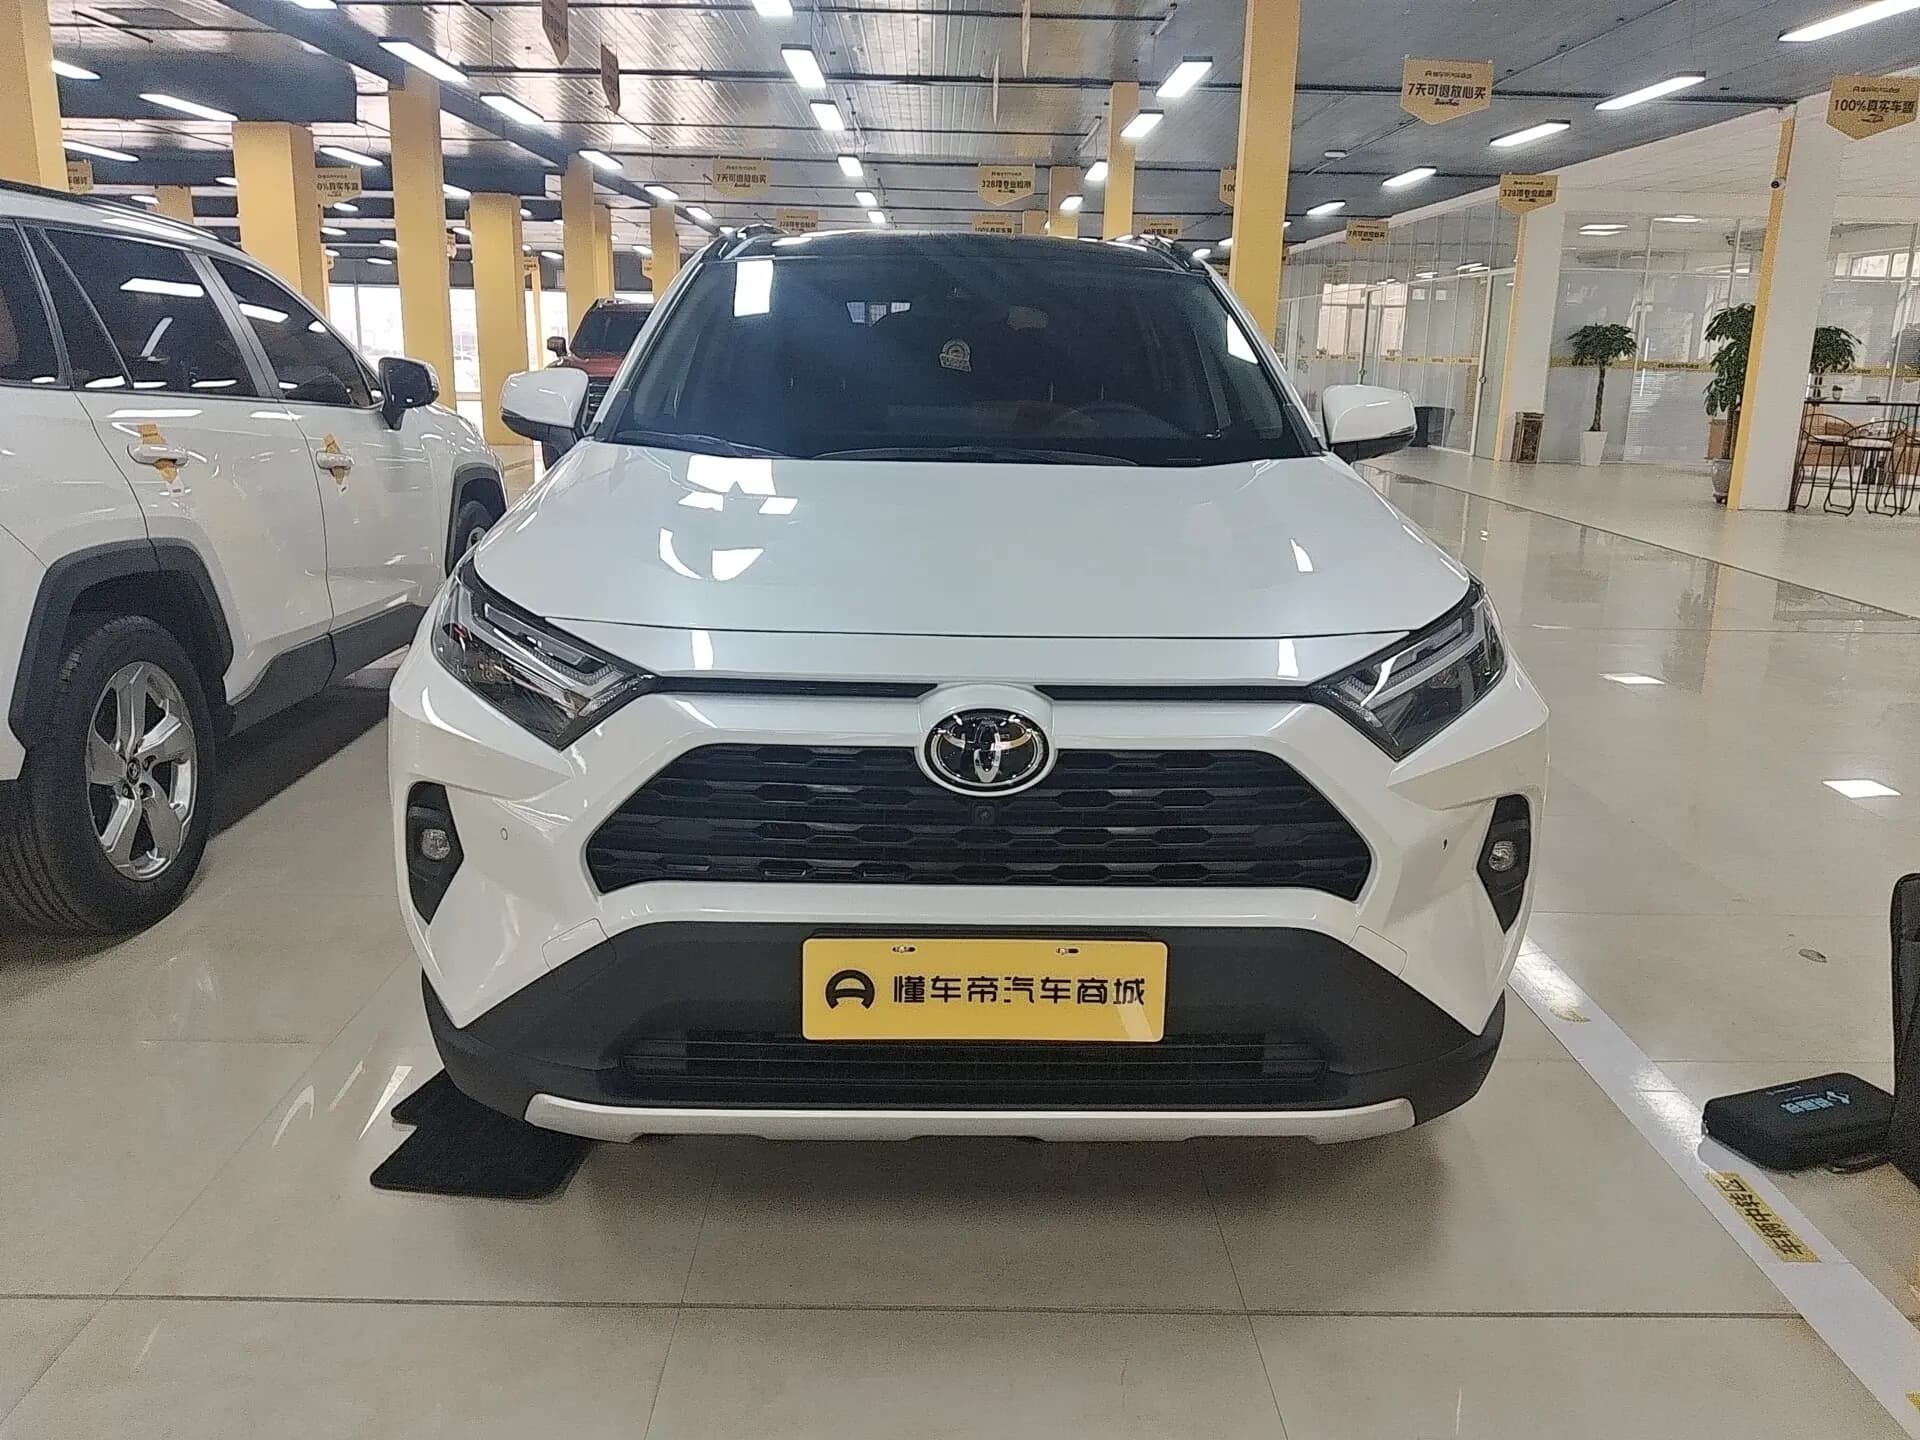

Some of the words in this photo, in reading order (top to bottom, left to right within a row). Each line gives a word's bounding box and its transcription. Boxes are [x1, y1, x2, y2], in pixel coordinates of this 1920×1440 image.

[893, 975, 1146, 1005] 懂车帝汽车商城
